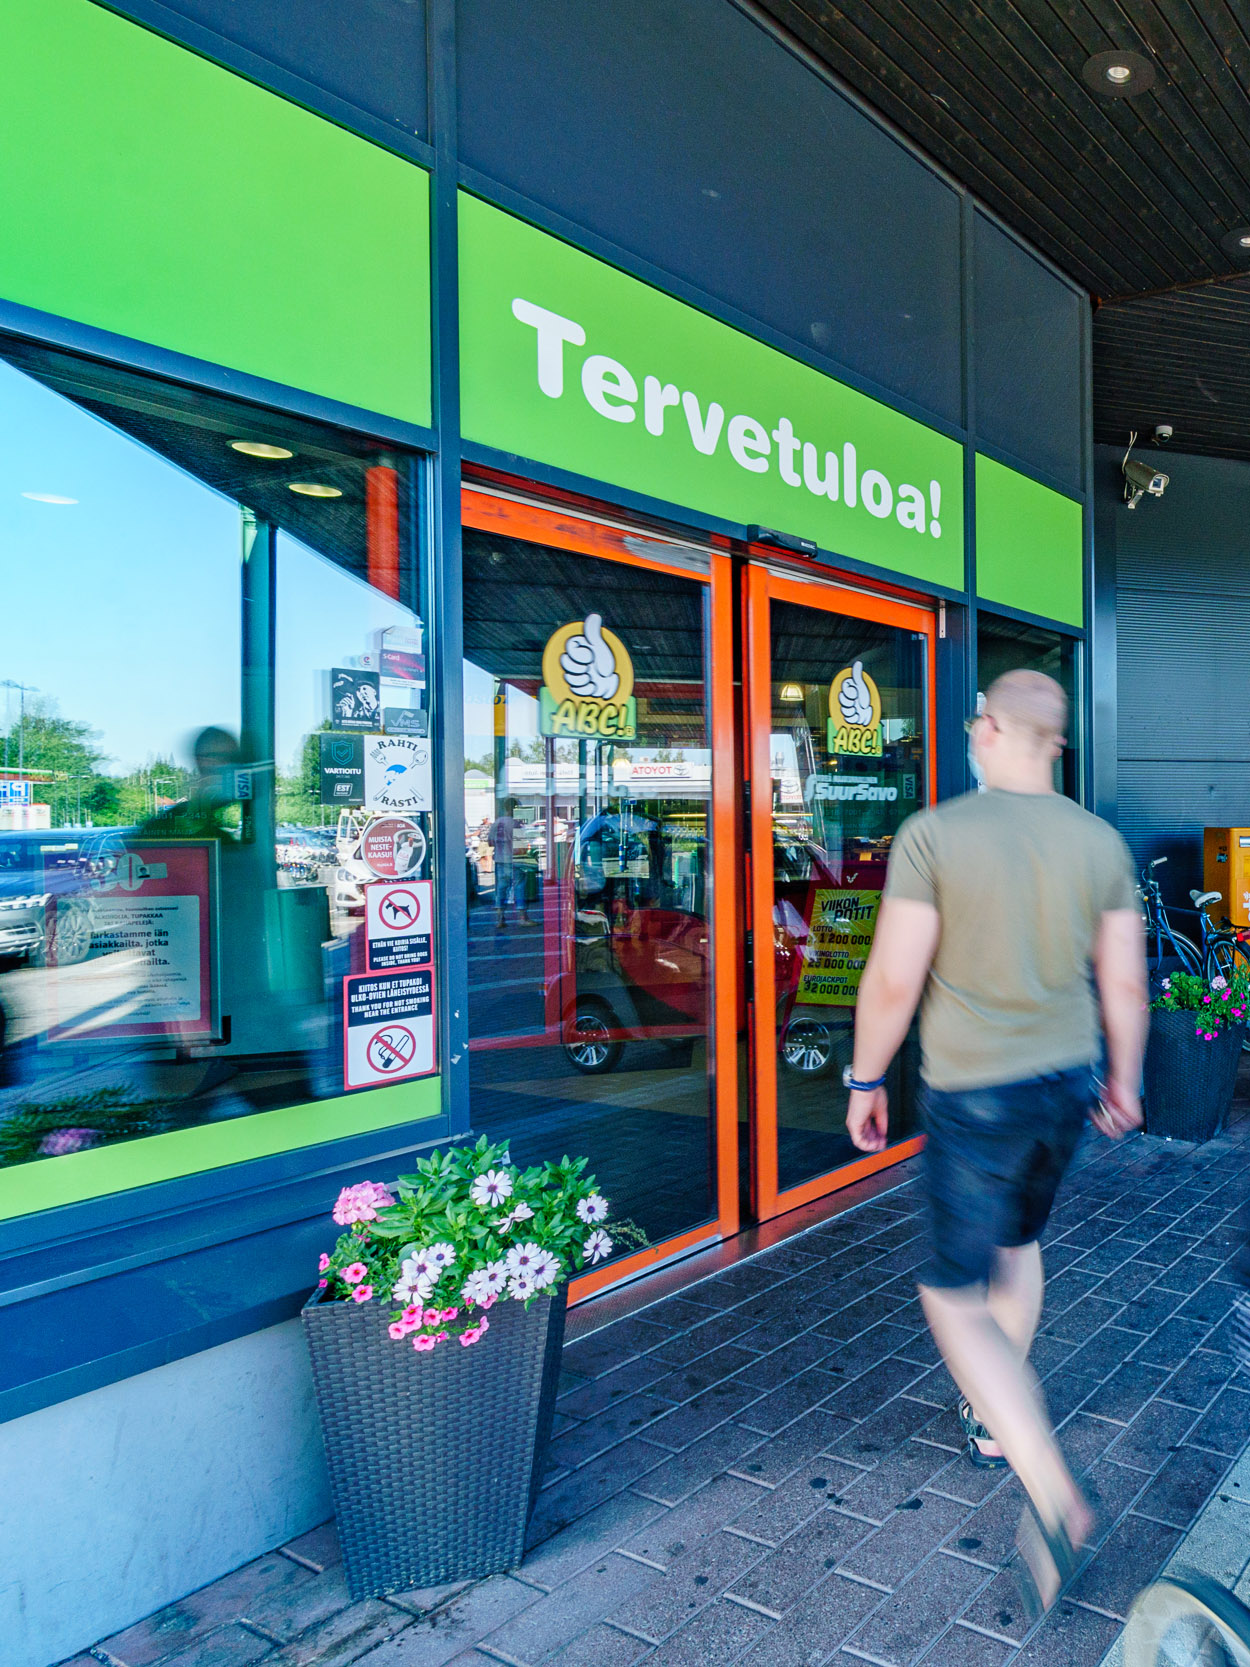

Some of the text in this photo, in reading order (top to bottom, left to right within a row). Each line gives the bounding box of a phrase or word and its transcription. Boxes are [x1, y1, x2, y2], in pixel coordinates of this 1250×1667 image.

[512, 298, 942, 539] Tervetuloa!
[551, 698, 628, 738] ABC!
[377, 739, 418, 752] RAHTI
[832, 725, 879, 755] ABC!
[324, 767, 362, 775] VARTIOITU
[238, 773, 250, 799] VISA
[904, 776, 914, 798] VISA
[381, 796, 418, 808] RASTI
[370, 843, 392, 851] NESTE-
[367, 851, 393, 859] KAASU!
[820, 897, 860, 912] VIIKON
[833, 905, 875, 922] POTIT
[154, 929, 169, 937] iän
[812, 925, 833, 933] LOTTO
[145, 938, 169, 949] jotka
[358, 978, 423, 993] KIITOS KUN ET TUPAKOI
[803, 974, 848, 984] EUROJACKPOT
[350, 984, 430, 1003] ULKO-OVIEN LÄHEISYYDESSÄ
[351, 1005, 370, 1014] THANK
[370, 1003, 382, 1011] YOU
[382, 1001, 394, 1009] FOR
[405, 996, 430, 1006] SMOKING
[363, 1010, 380, 1019] NEAR
[390, 1004, 419, 1015] ENTRANCE
